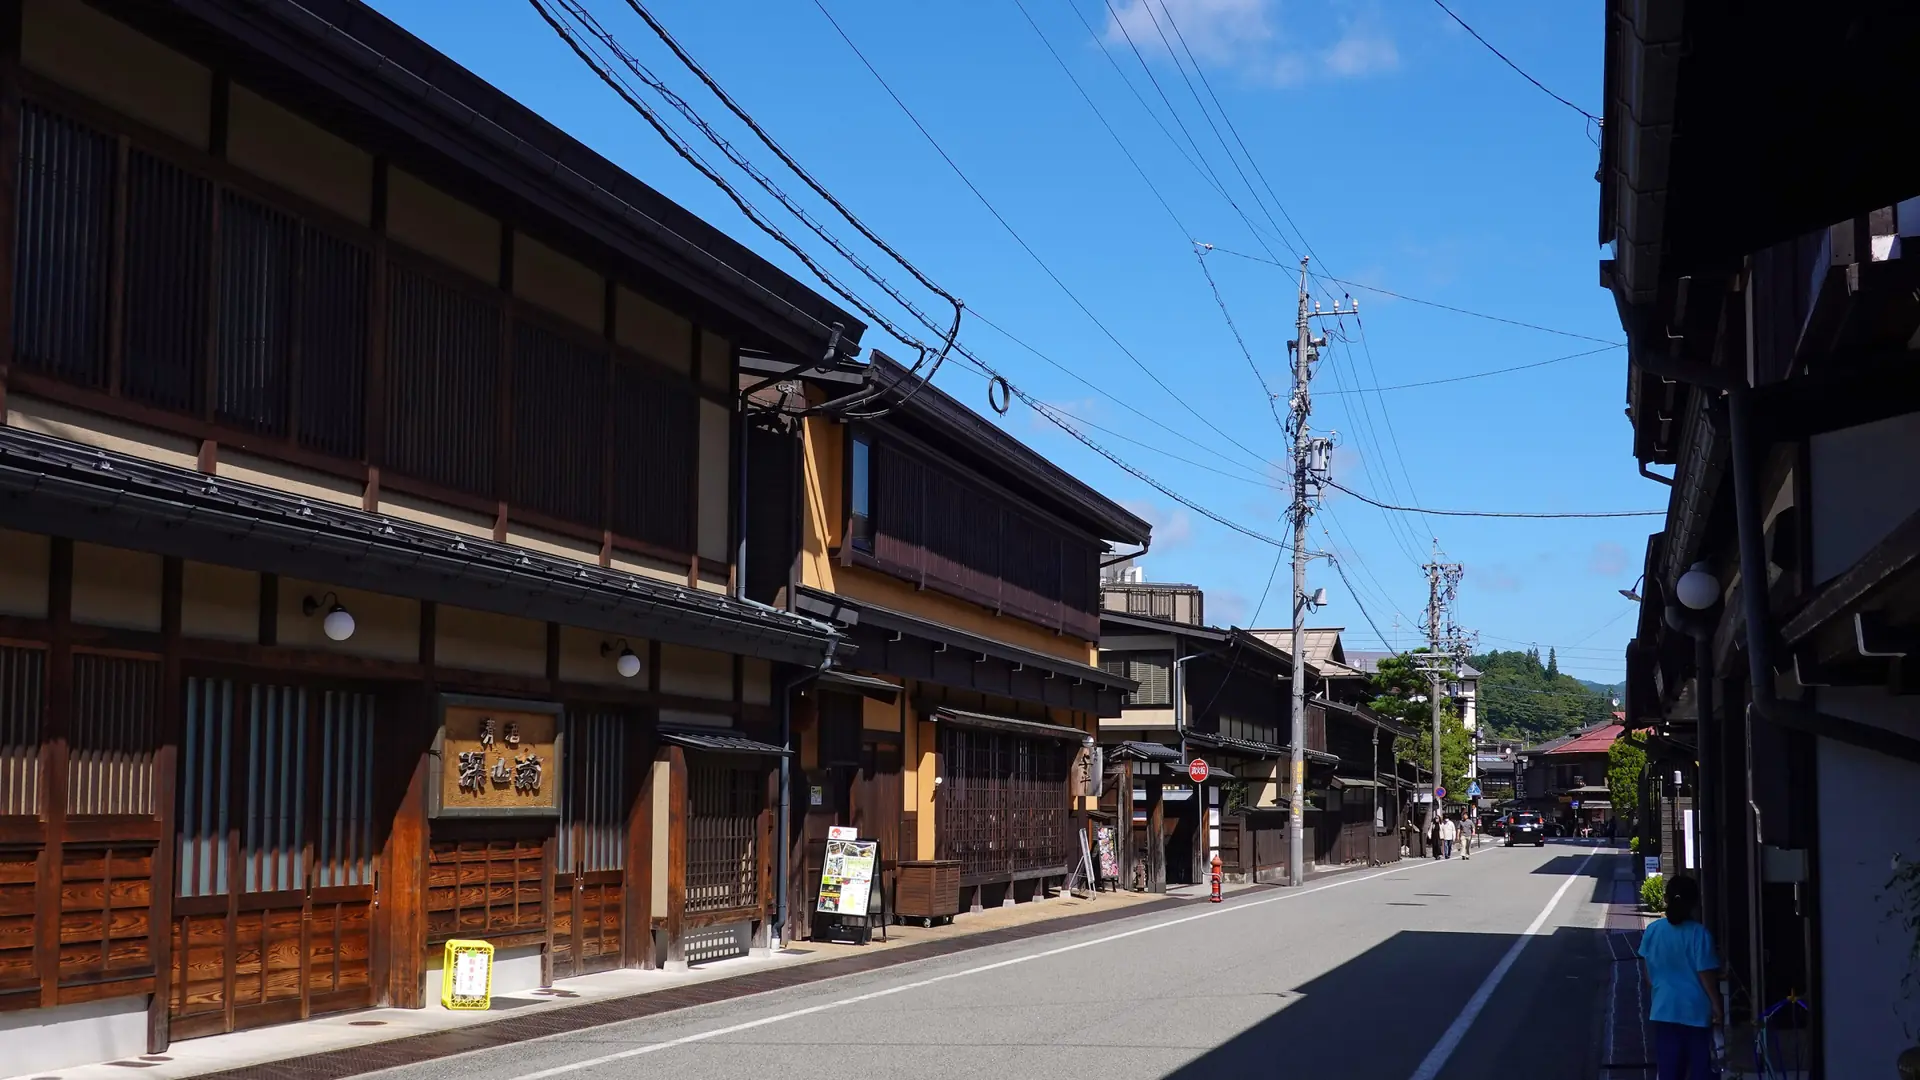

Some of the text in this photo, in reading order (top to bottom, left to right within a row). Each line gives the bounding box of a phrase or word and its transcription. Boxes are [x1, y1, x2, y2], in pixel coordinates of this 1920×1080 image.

[480, 717, 521, 745] 清酒
[458, 752, 544, 791] 深山菊
[1191, 766, 1206, 775] 消火栓
